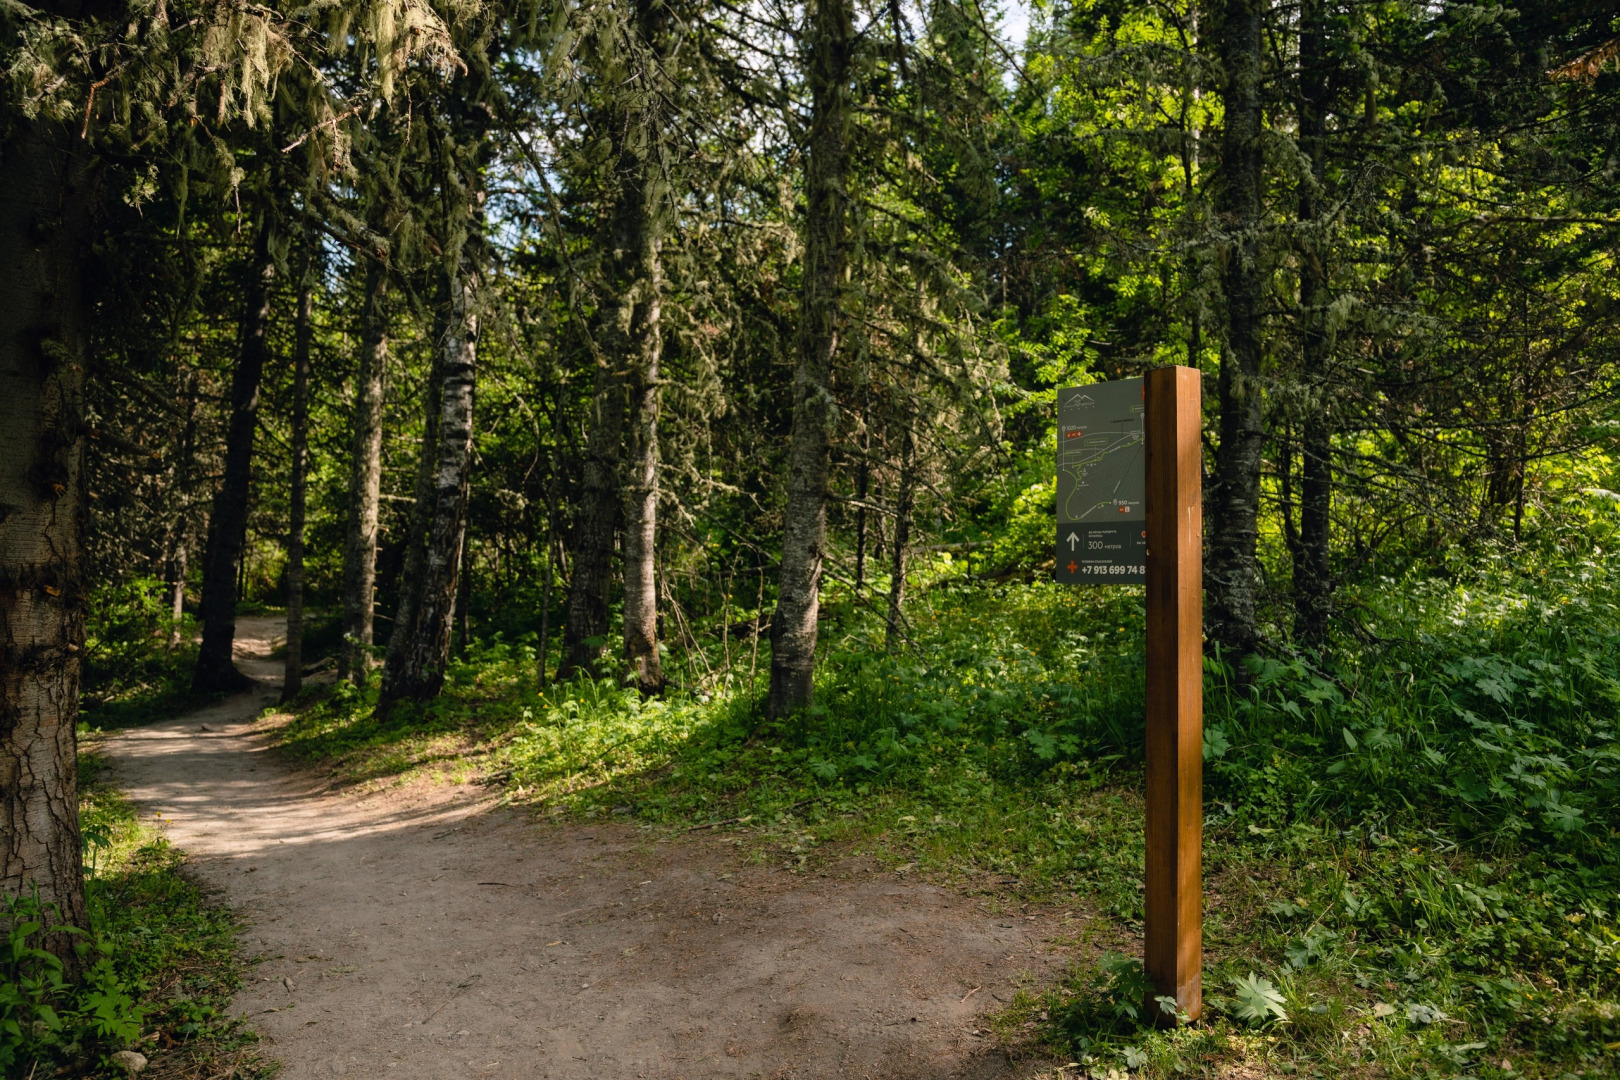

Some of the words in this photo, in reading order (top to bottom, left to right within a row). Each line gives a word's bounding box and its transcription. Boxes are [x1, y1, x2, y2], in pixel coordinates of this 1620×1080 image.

[1088, 541, 1103, 549] 300
[1082, 565, 1092, 574] +7
[1093, 565, 1107, 574] 913
[1109, 565, 1125, 574] 699
[1127, 565, 1138, 574] 74
[1139, 565, 1146, 574] 8
